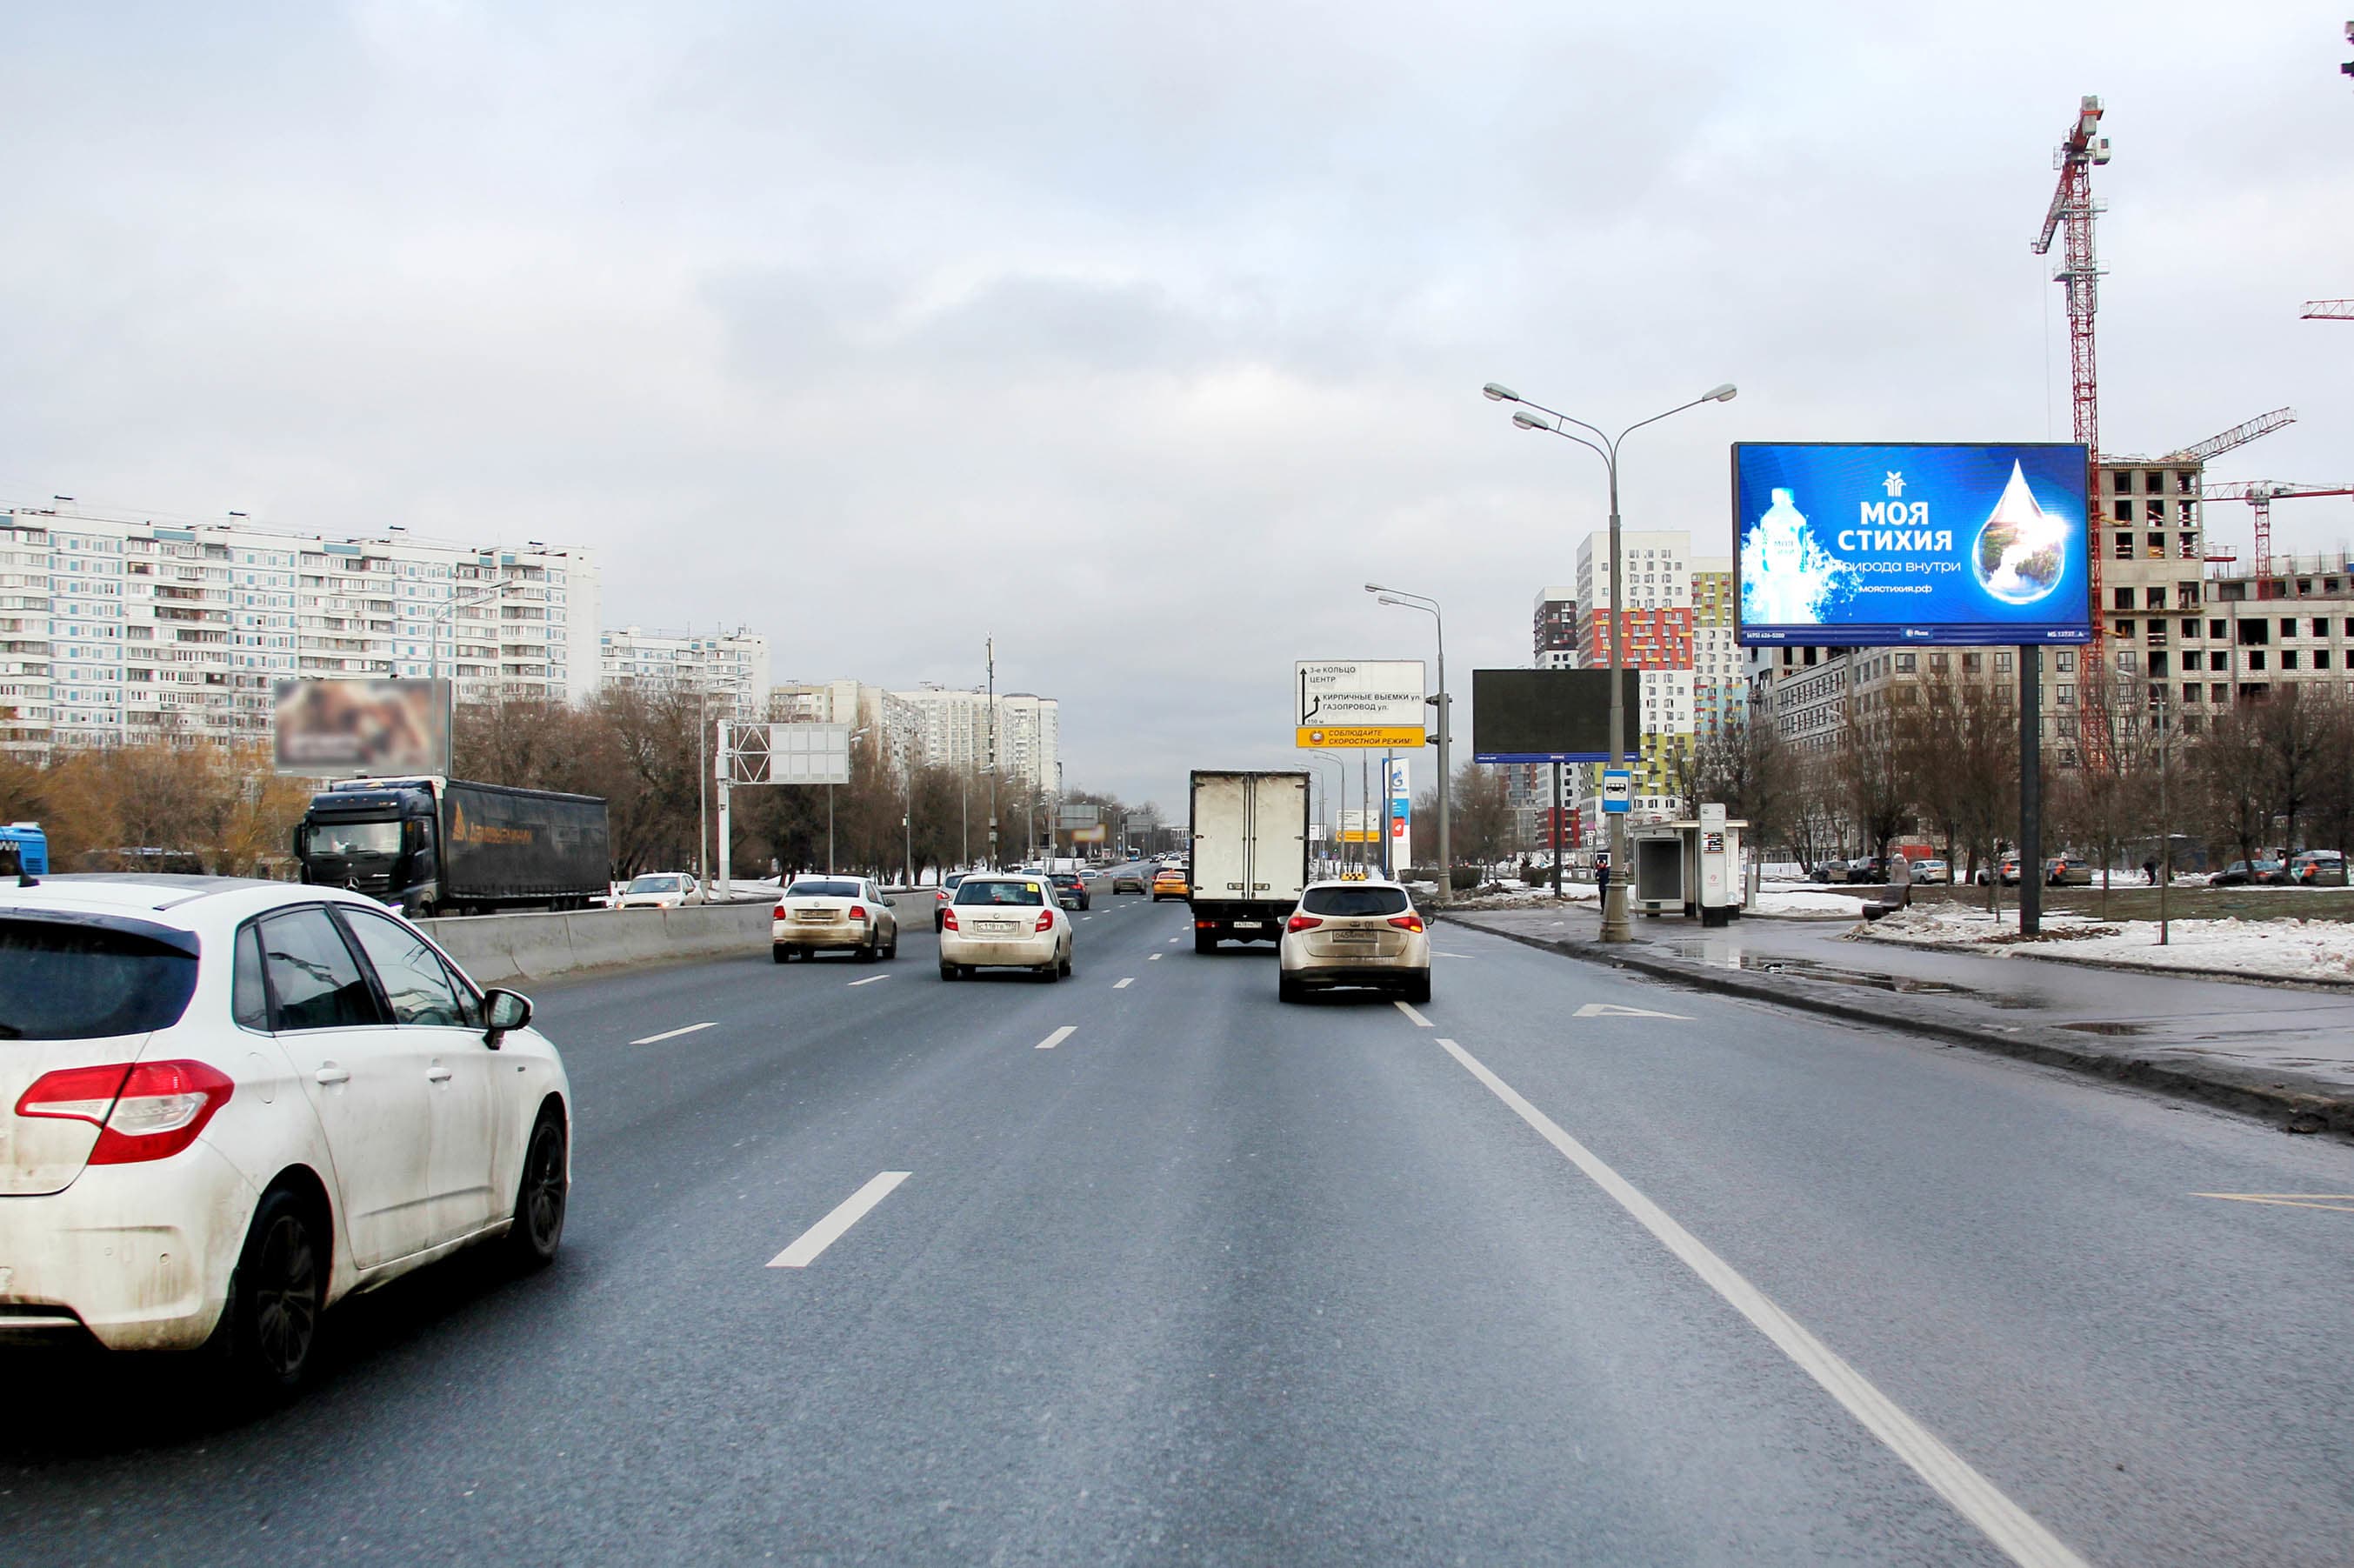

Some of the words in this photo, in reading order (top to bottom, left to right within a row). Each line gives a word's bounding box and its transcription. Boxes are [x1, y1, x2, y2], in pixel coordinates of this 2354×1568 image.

[1860, 501, 1929, 525] МОЯ
[1837, 530, 1952, 551] СТИХИЯ
[1906, 562, 1962, 575] внутри
[1859, 584, 1933, 595] моястихия.рф
